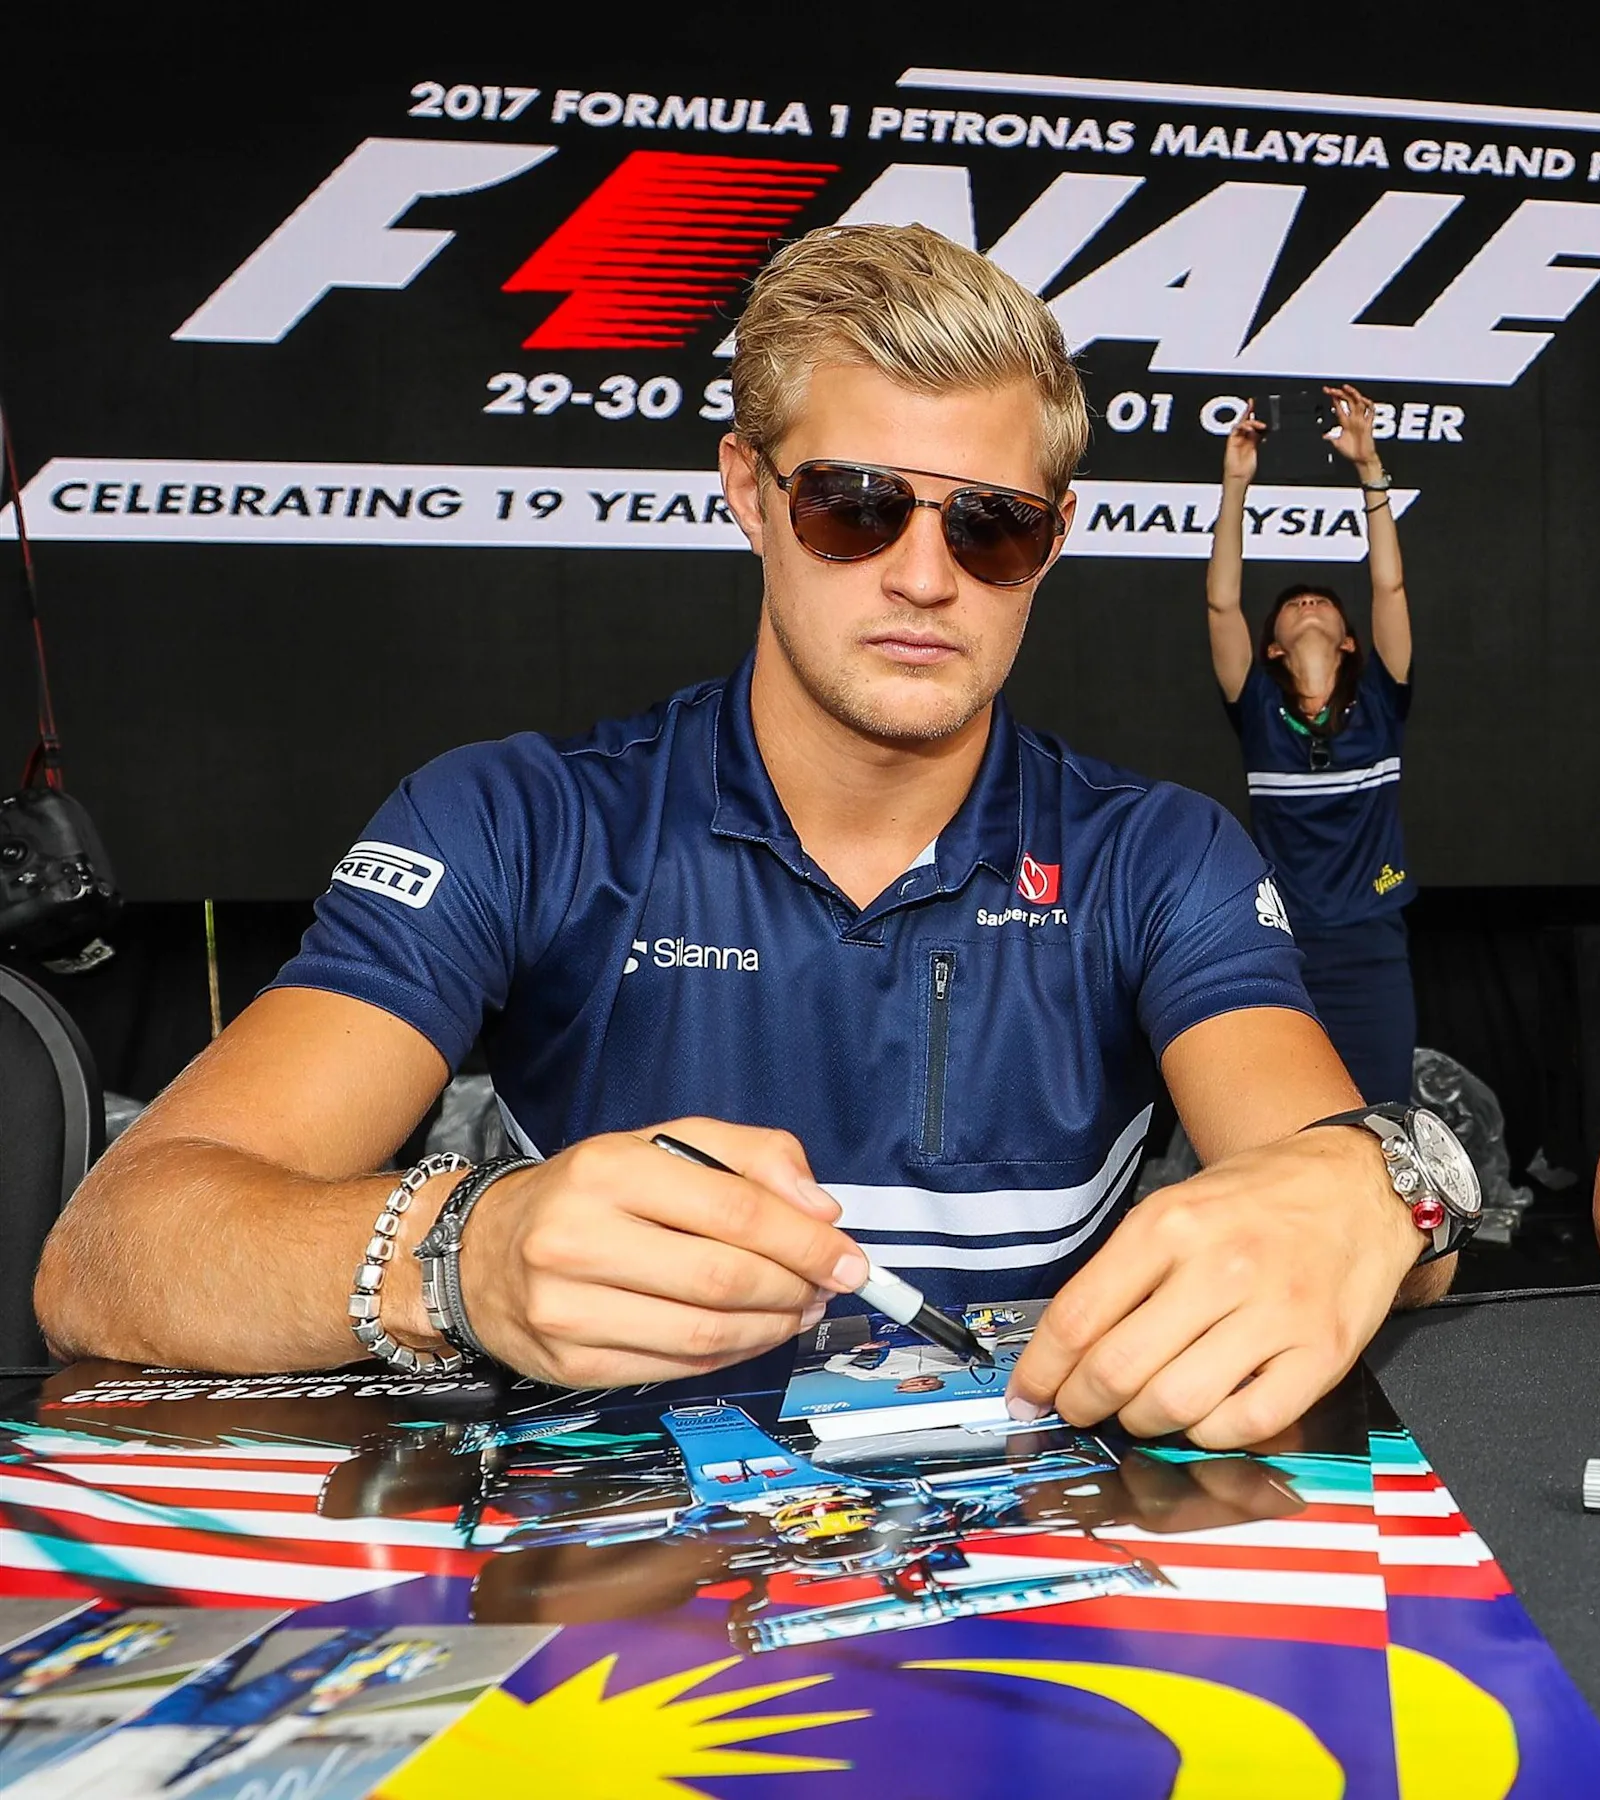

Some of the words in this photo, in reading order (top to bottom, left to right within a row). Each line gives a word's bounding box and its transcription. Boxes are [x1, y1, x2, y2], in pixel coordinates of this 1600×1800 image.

[408, 80, 541, 122] 2017
[551, 89, 812, 136] FORMULA
[829, 104, 850, 138] 1
[867, 106, 1136, 155] PETRONAS
[1150, 124, 1390, 169] MALAYSIA
[1403, 140, 1576, 181] GRAND
[483, 373, 684, 420] 29-30
[1107, 392, 1174, 433] 01
[1199, 395, 1465, 442] OBER
[51, 481, 463, 520] CELEBRATING
[495, 490, 564, 521] 19
[589, 492, 735, 525] YEAR
[1087, 502, 1363, 538] MALYSIA
[334, 861, 425, 897] RELLI
[653, 936, 760, 972] Silanna
[61, 1387, 208, 1403] 2222
[207, 1382, 344, 1400] 8778
